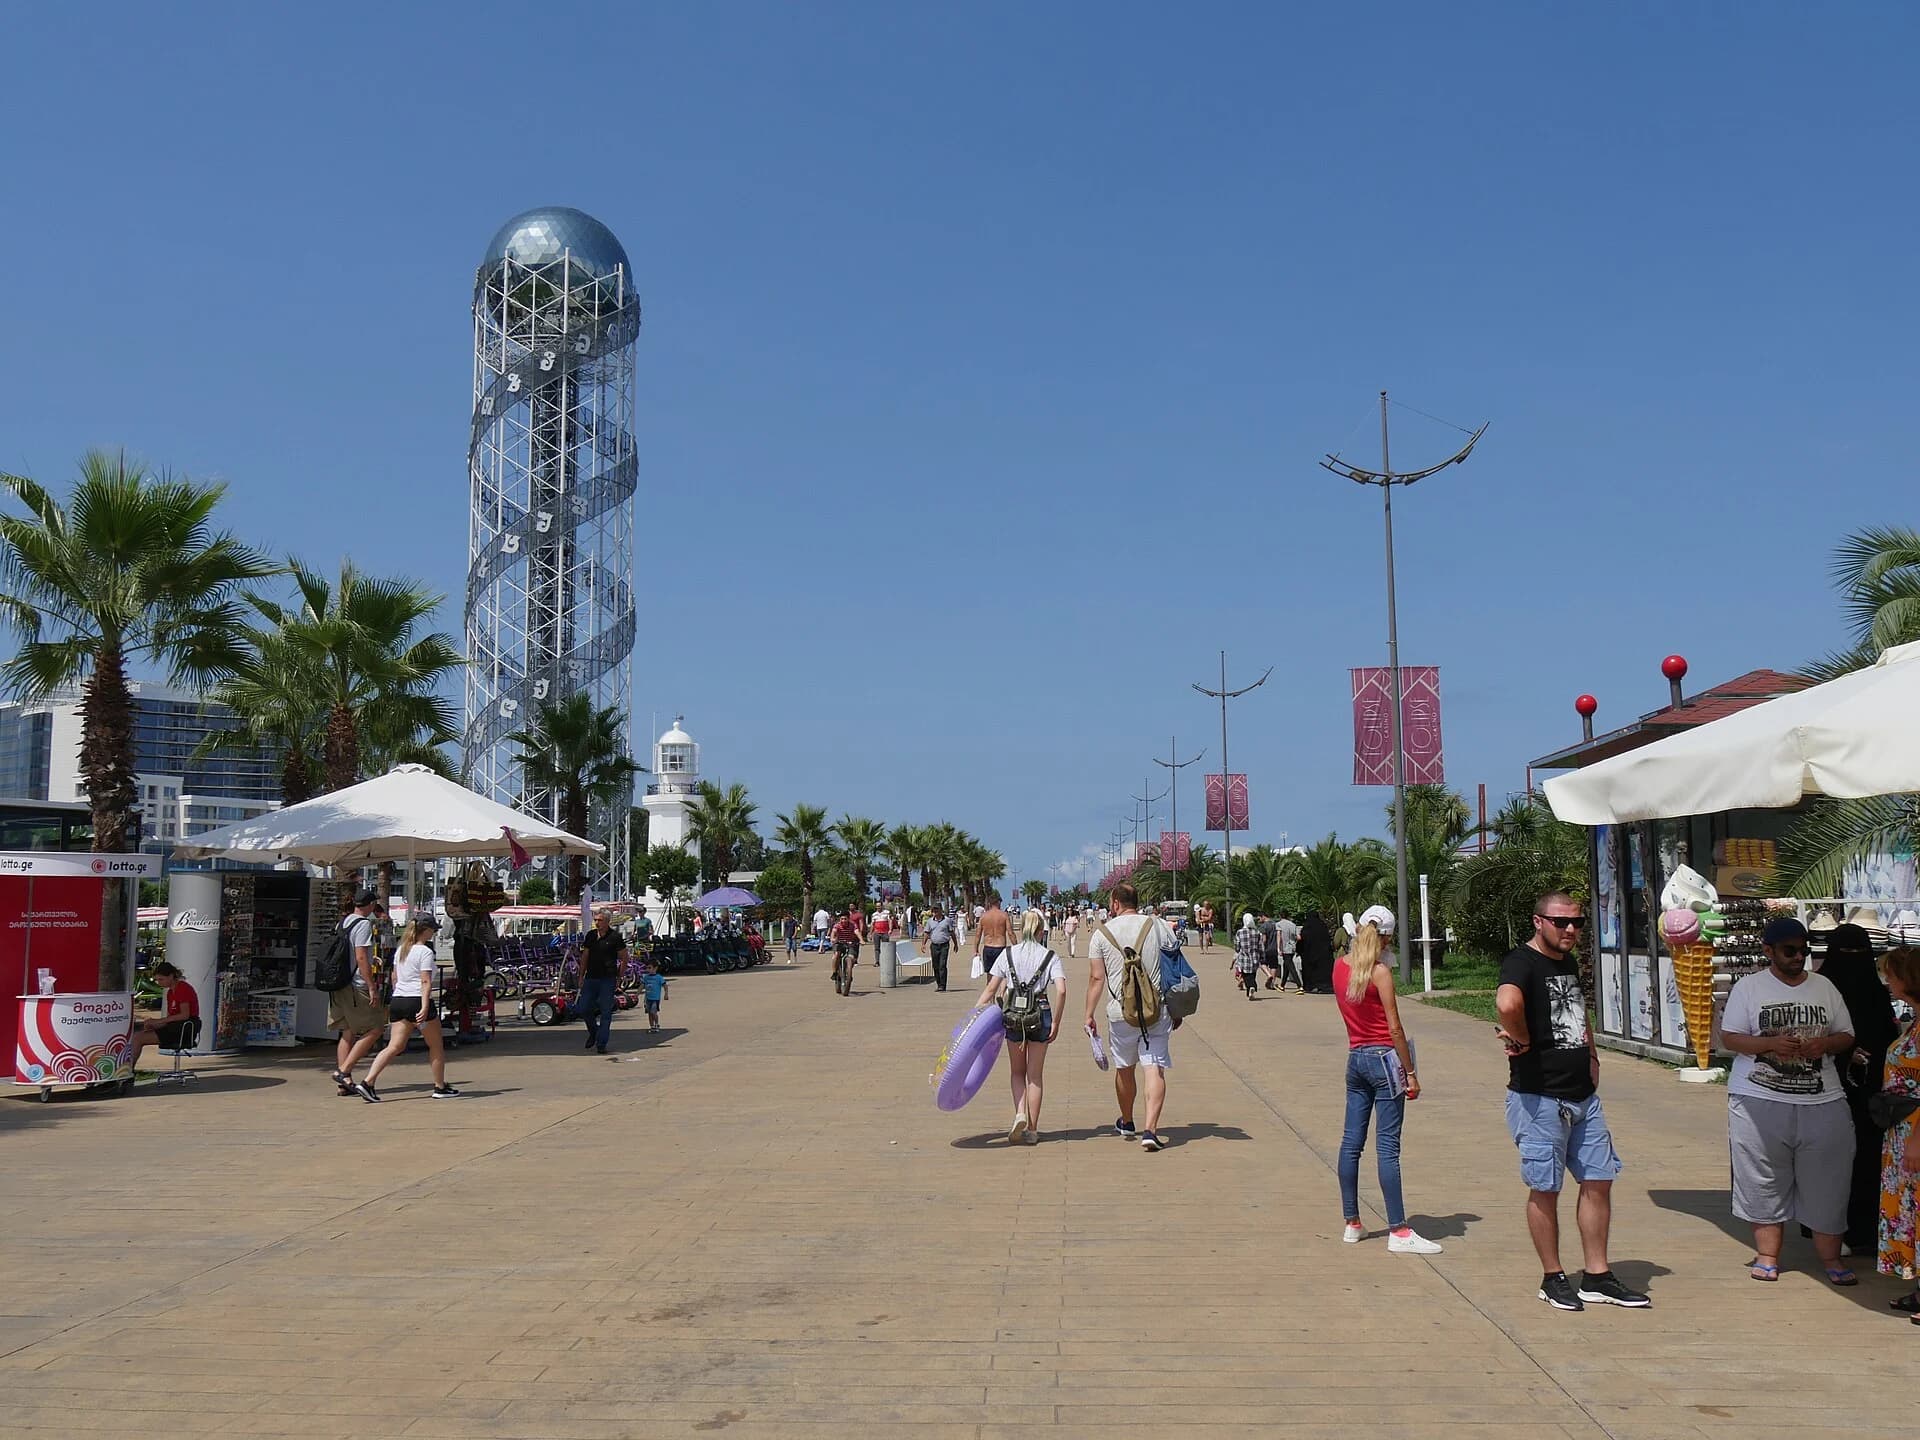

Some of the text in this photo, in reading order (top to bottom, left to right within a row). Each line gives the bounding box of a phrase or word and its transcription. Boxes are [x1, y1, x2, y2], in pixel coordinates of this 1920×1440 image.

[1409, 695, 1433, 755] ECLIPSE
[1, 858, 33, 872] lotto.ge
[108, 861, 148, 874] lotto.ge
[73, 1001, 124, 1014] მოგება
[1759, 1005, 1828, 1030] BOWLING
